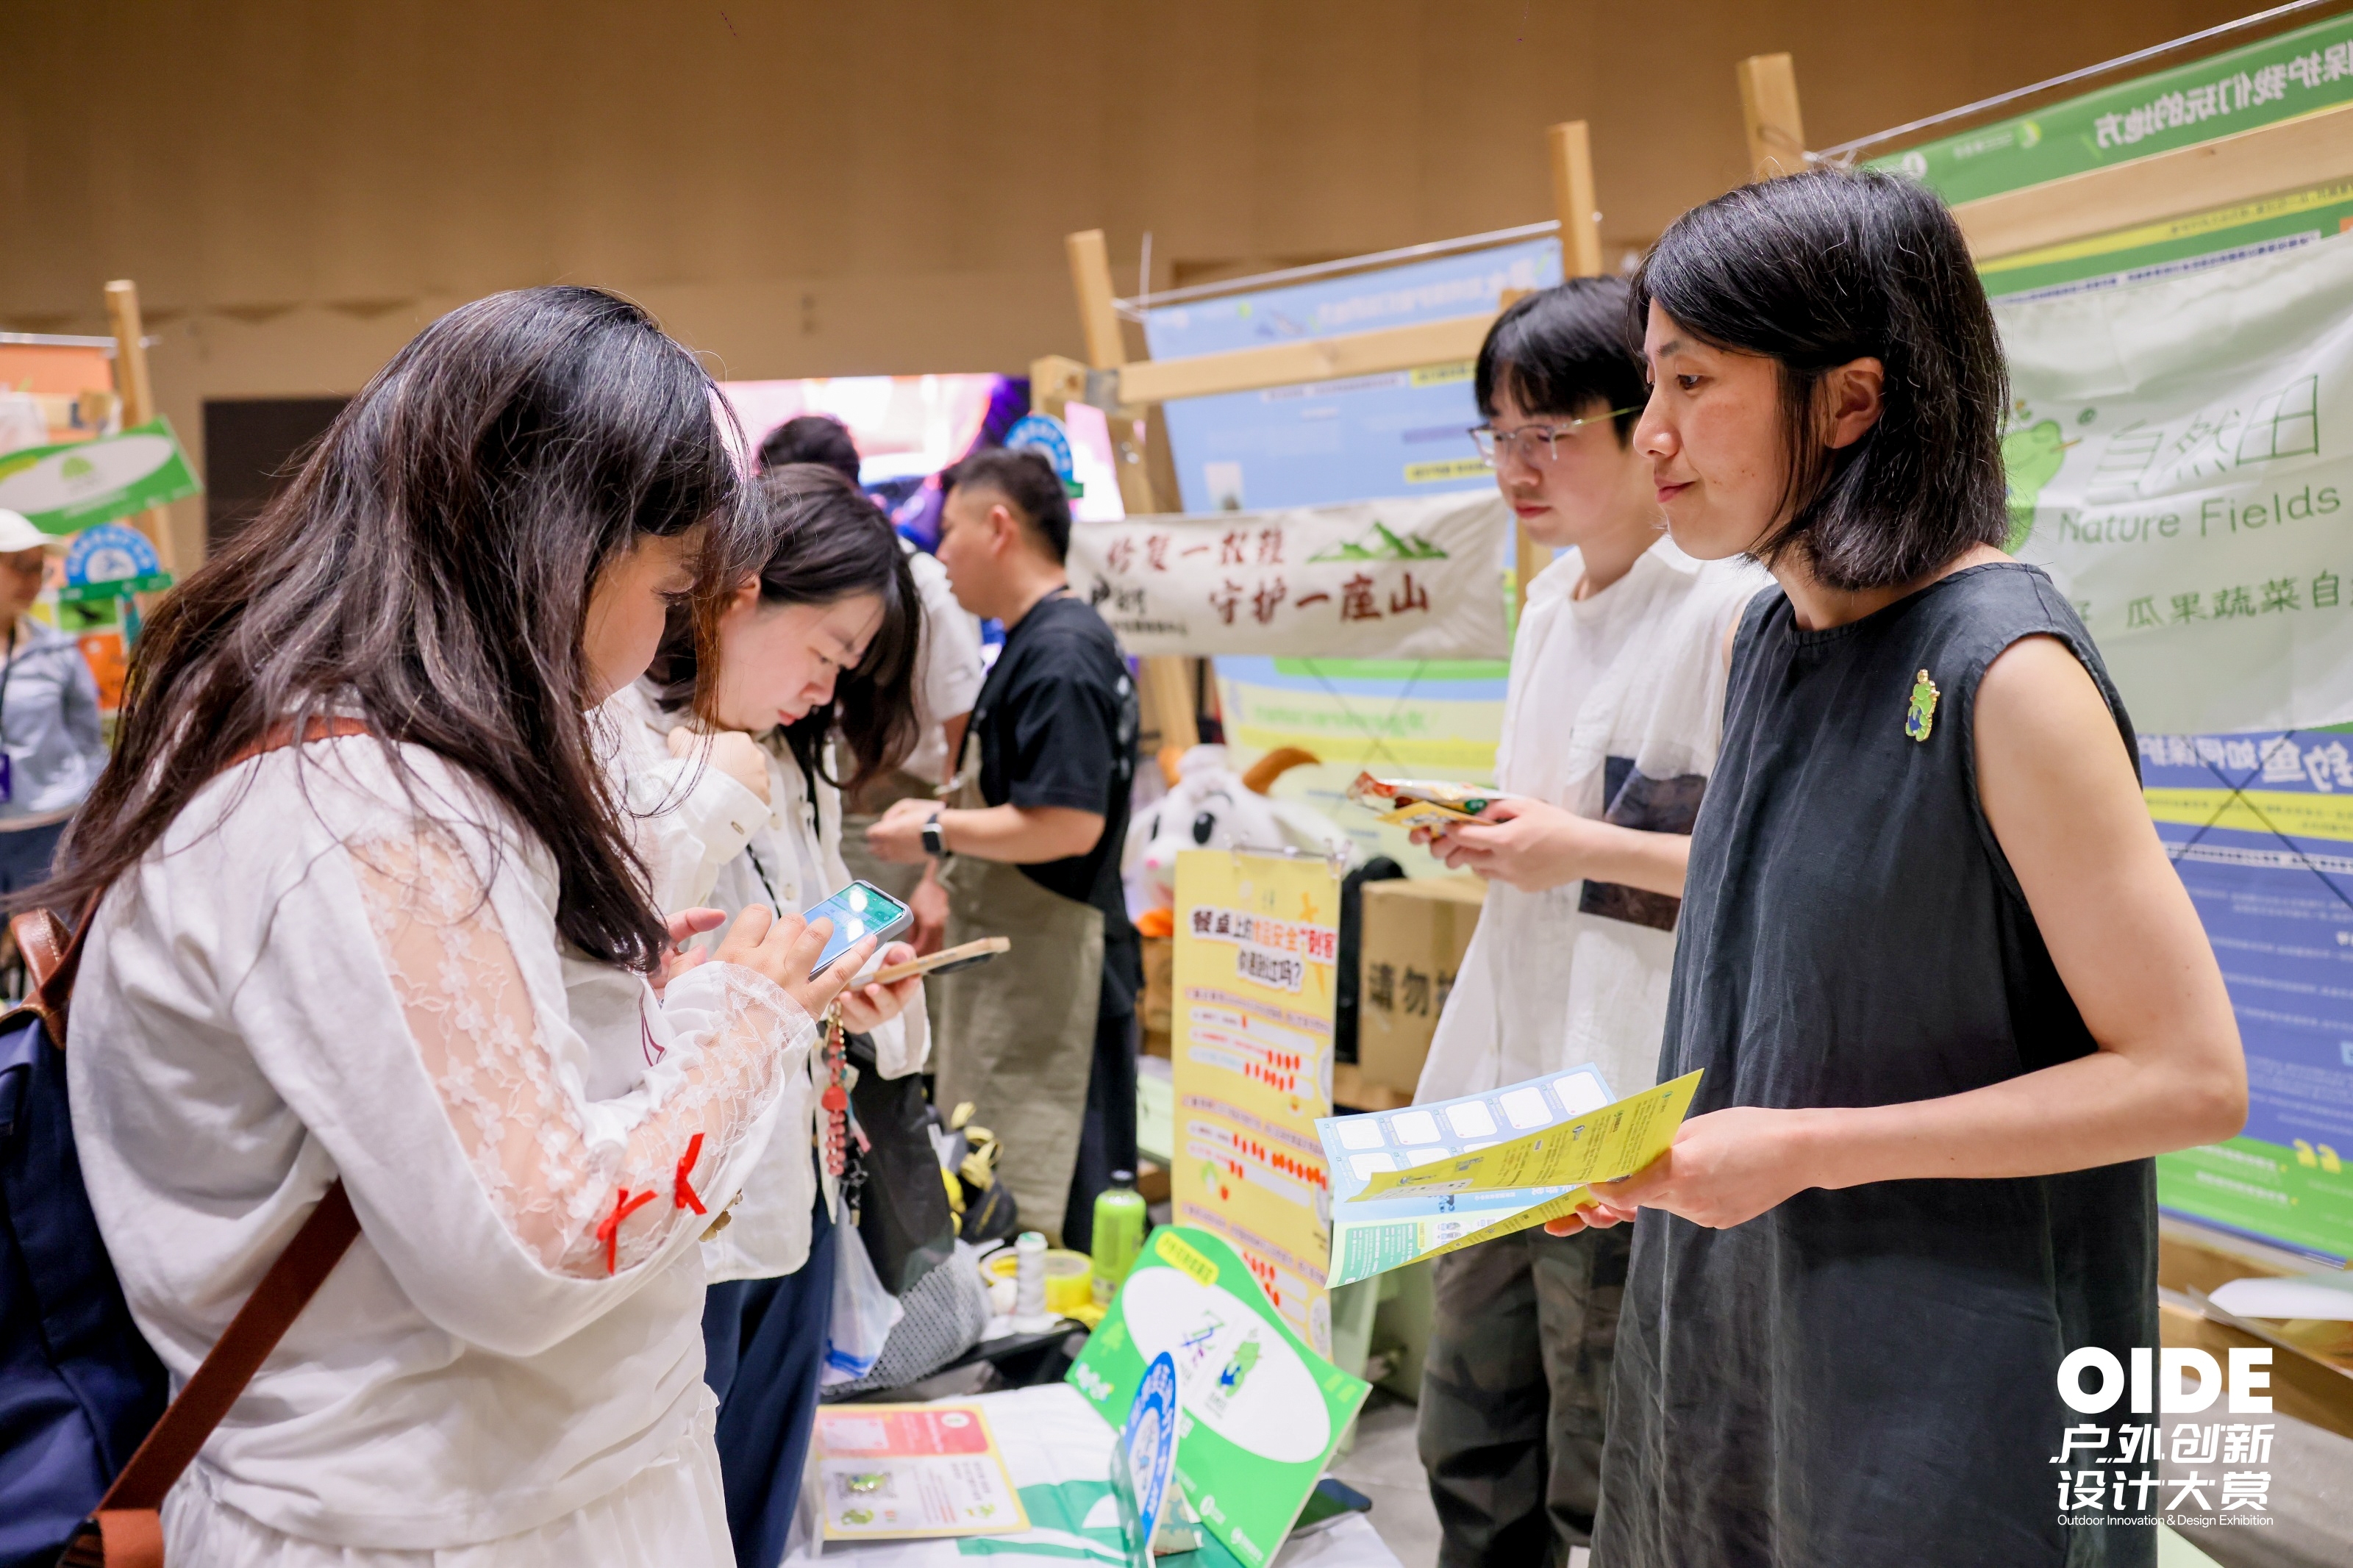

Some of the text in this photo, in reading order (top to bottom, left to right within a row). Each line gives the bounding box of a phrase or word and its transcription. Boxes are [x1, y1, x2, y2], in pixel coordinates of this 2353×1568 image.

[2085, 373, 2319, 507] 自然田
[2059, 484, 2341, 544] Nature Fields
[1209, 571, 1432, 626] 守护一座山
[2127, 569, 2353, 629] 瓜果蔬菜自
